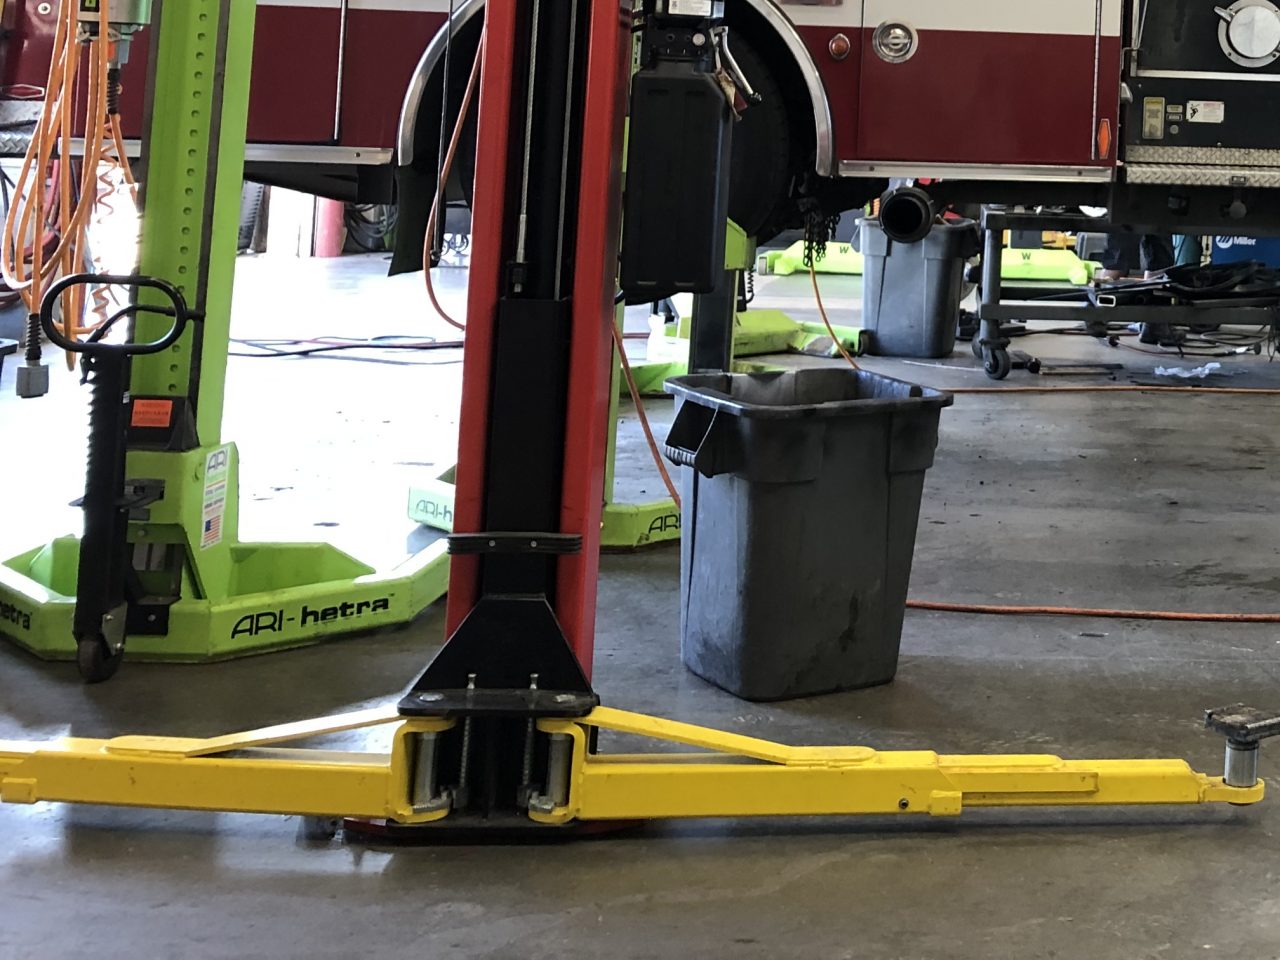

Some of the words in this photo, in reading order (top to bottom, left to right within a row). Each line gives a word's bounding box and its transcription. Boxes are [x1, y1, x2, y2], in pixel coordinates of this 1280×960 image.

[1233, 236, 1257, 246] Miller
[415, 499, 453, 523] ARI-h
[648, 513, 682, 534] ARI
[230, 597, 390, 640] ARI-hetra
